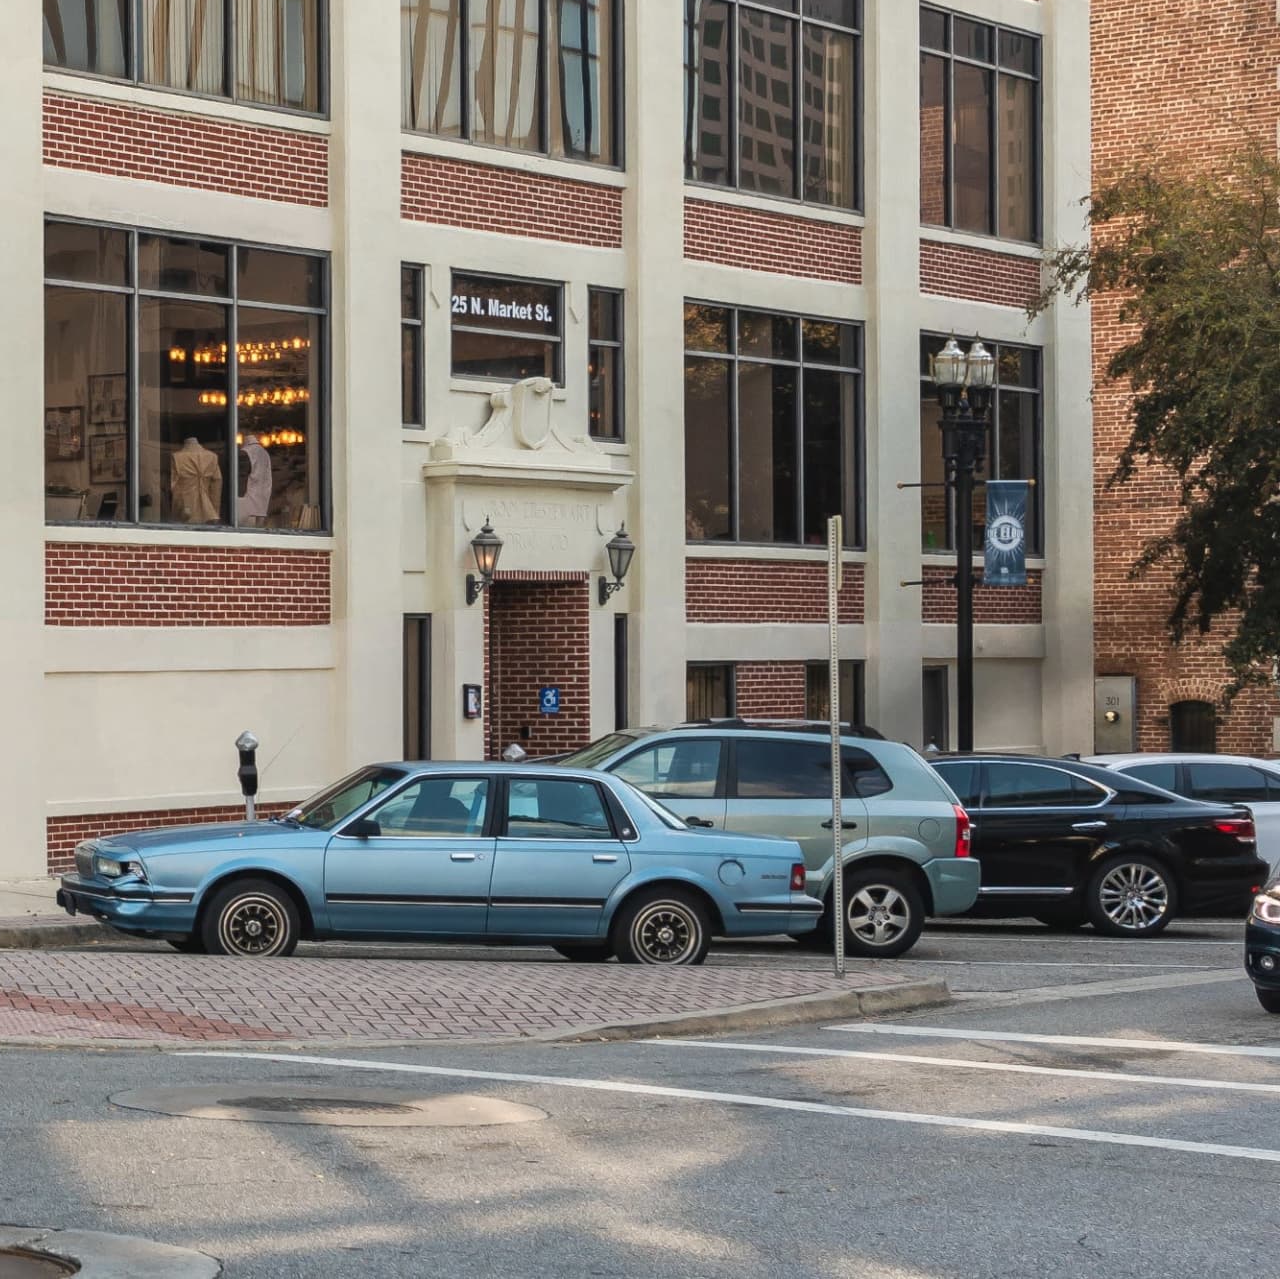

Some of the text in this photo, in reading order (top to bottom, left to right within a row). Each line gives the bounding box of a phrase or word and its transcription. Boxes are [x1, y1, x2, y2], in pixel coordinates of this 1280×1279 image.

[451, 295, 553, 322] 25 N. Market St.
[1105, 696, 1120, 706] 301
